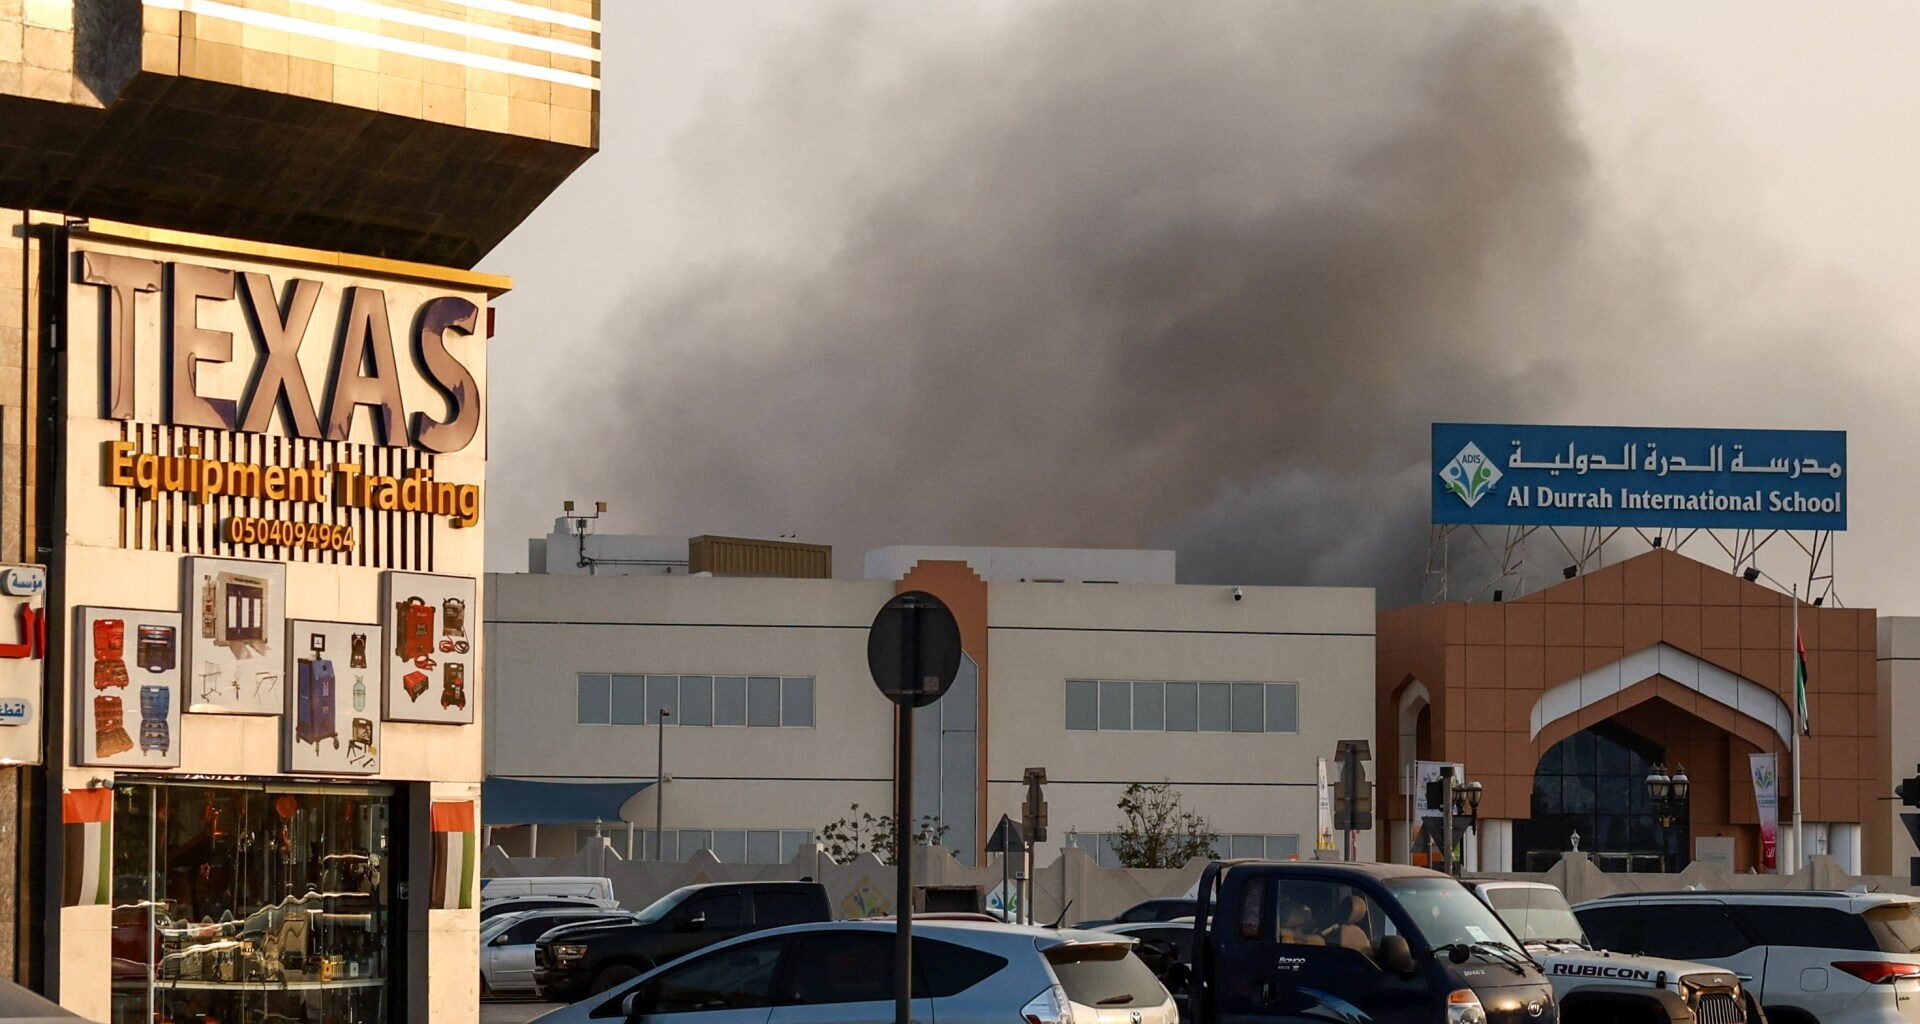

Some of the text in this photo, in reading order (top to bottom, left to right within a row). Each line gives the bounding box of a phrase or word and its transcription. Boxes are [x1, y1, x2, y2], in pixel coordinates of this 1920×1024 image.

[77, 250, 480, 453] TEXAS
[1461, 454, 1481, 464] ADIS
[1508, 440, 1842, 479] مدرسة الدرة الدولية
[109, 441, 480, 527] Equipment Trading
[1507, 486, 1841, 513] Al Durrah International School
[230, 516, 355, 551] 0504094964
[1553, 963, 1650, 980] RUBICON
